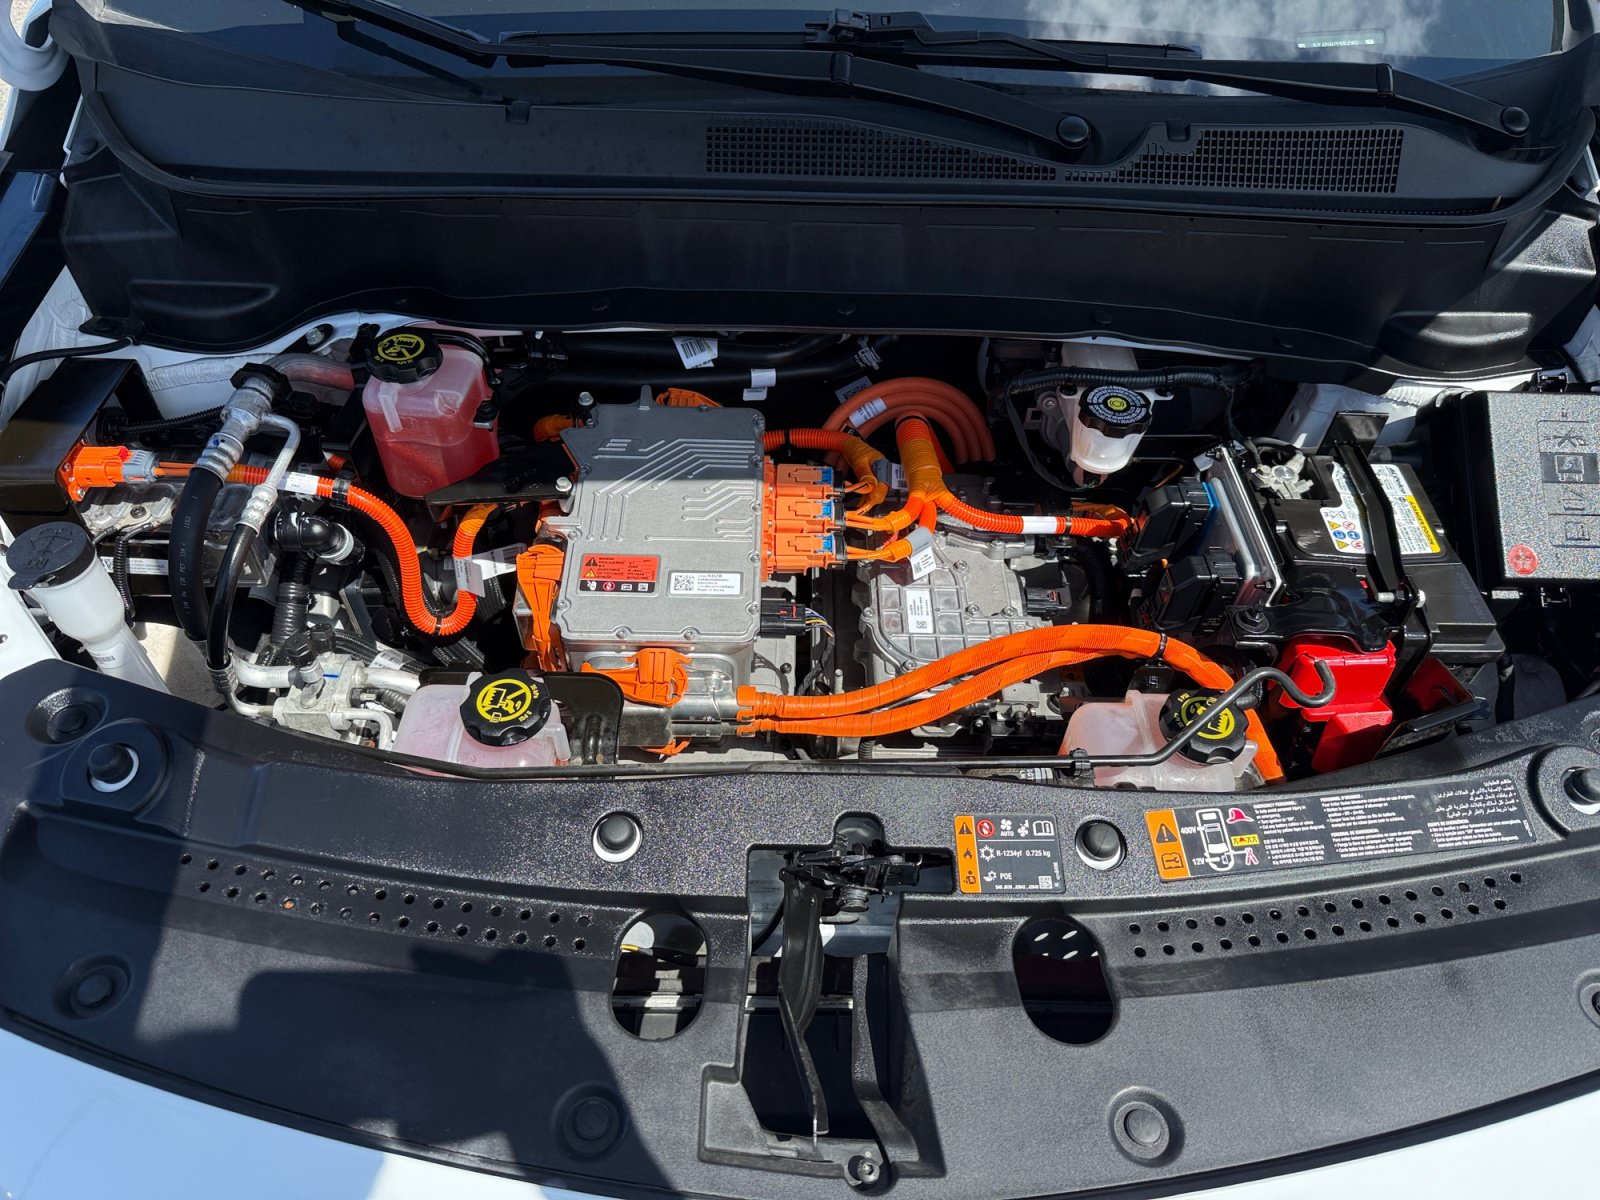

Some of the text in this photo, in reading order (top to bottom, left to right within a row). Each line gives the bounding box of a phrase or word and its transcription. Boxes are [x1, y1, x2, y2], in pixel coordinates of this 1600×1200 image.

[1180, 826, 1196, 834] 400V
[996, 849, 1051, 858] R-1234yf 0.725 kg
[1192, 857, 1204, 866] 12V
[999, 872, 1013, 880] POE
